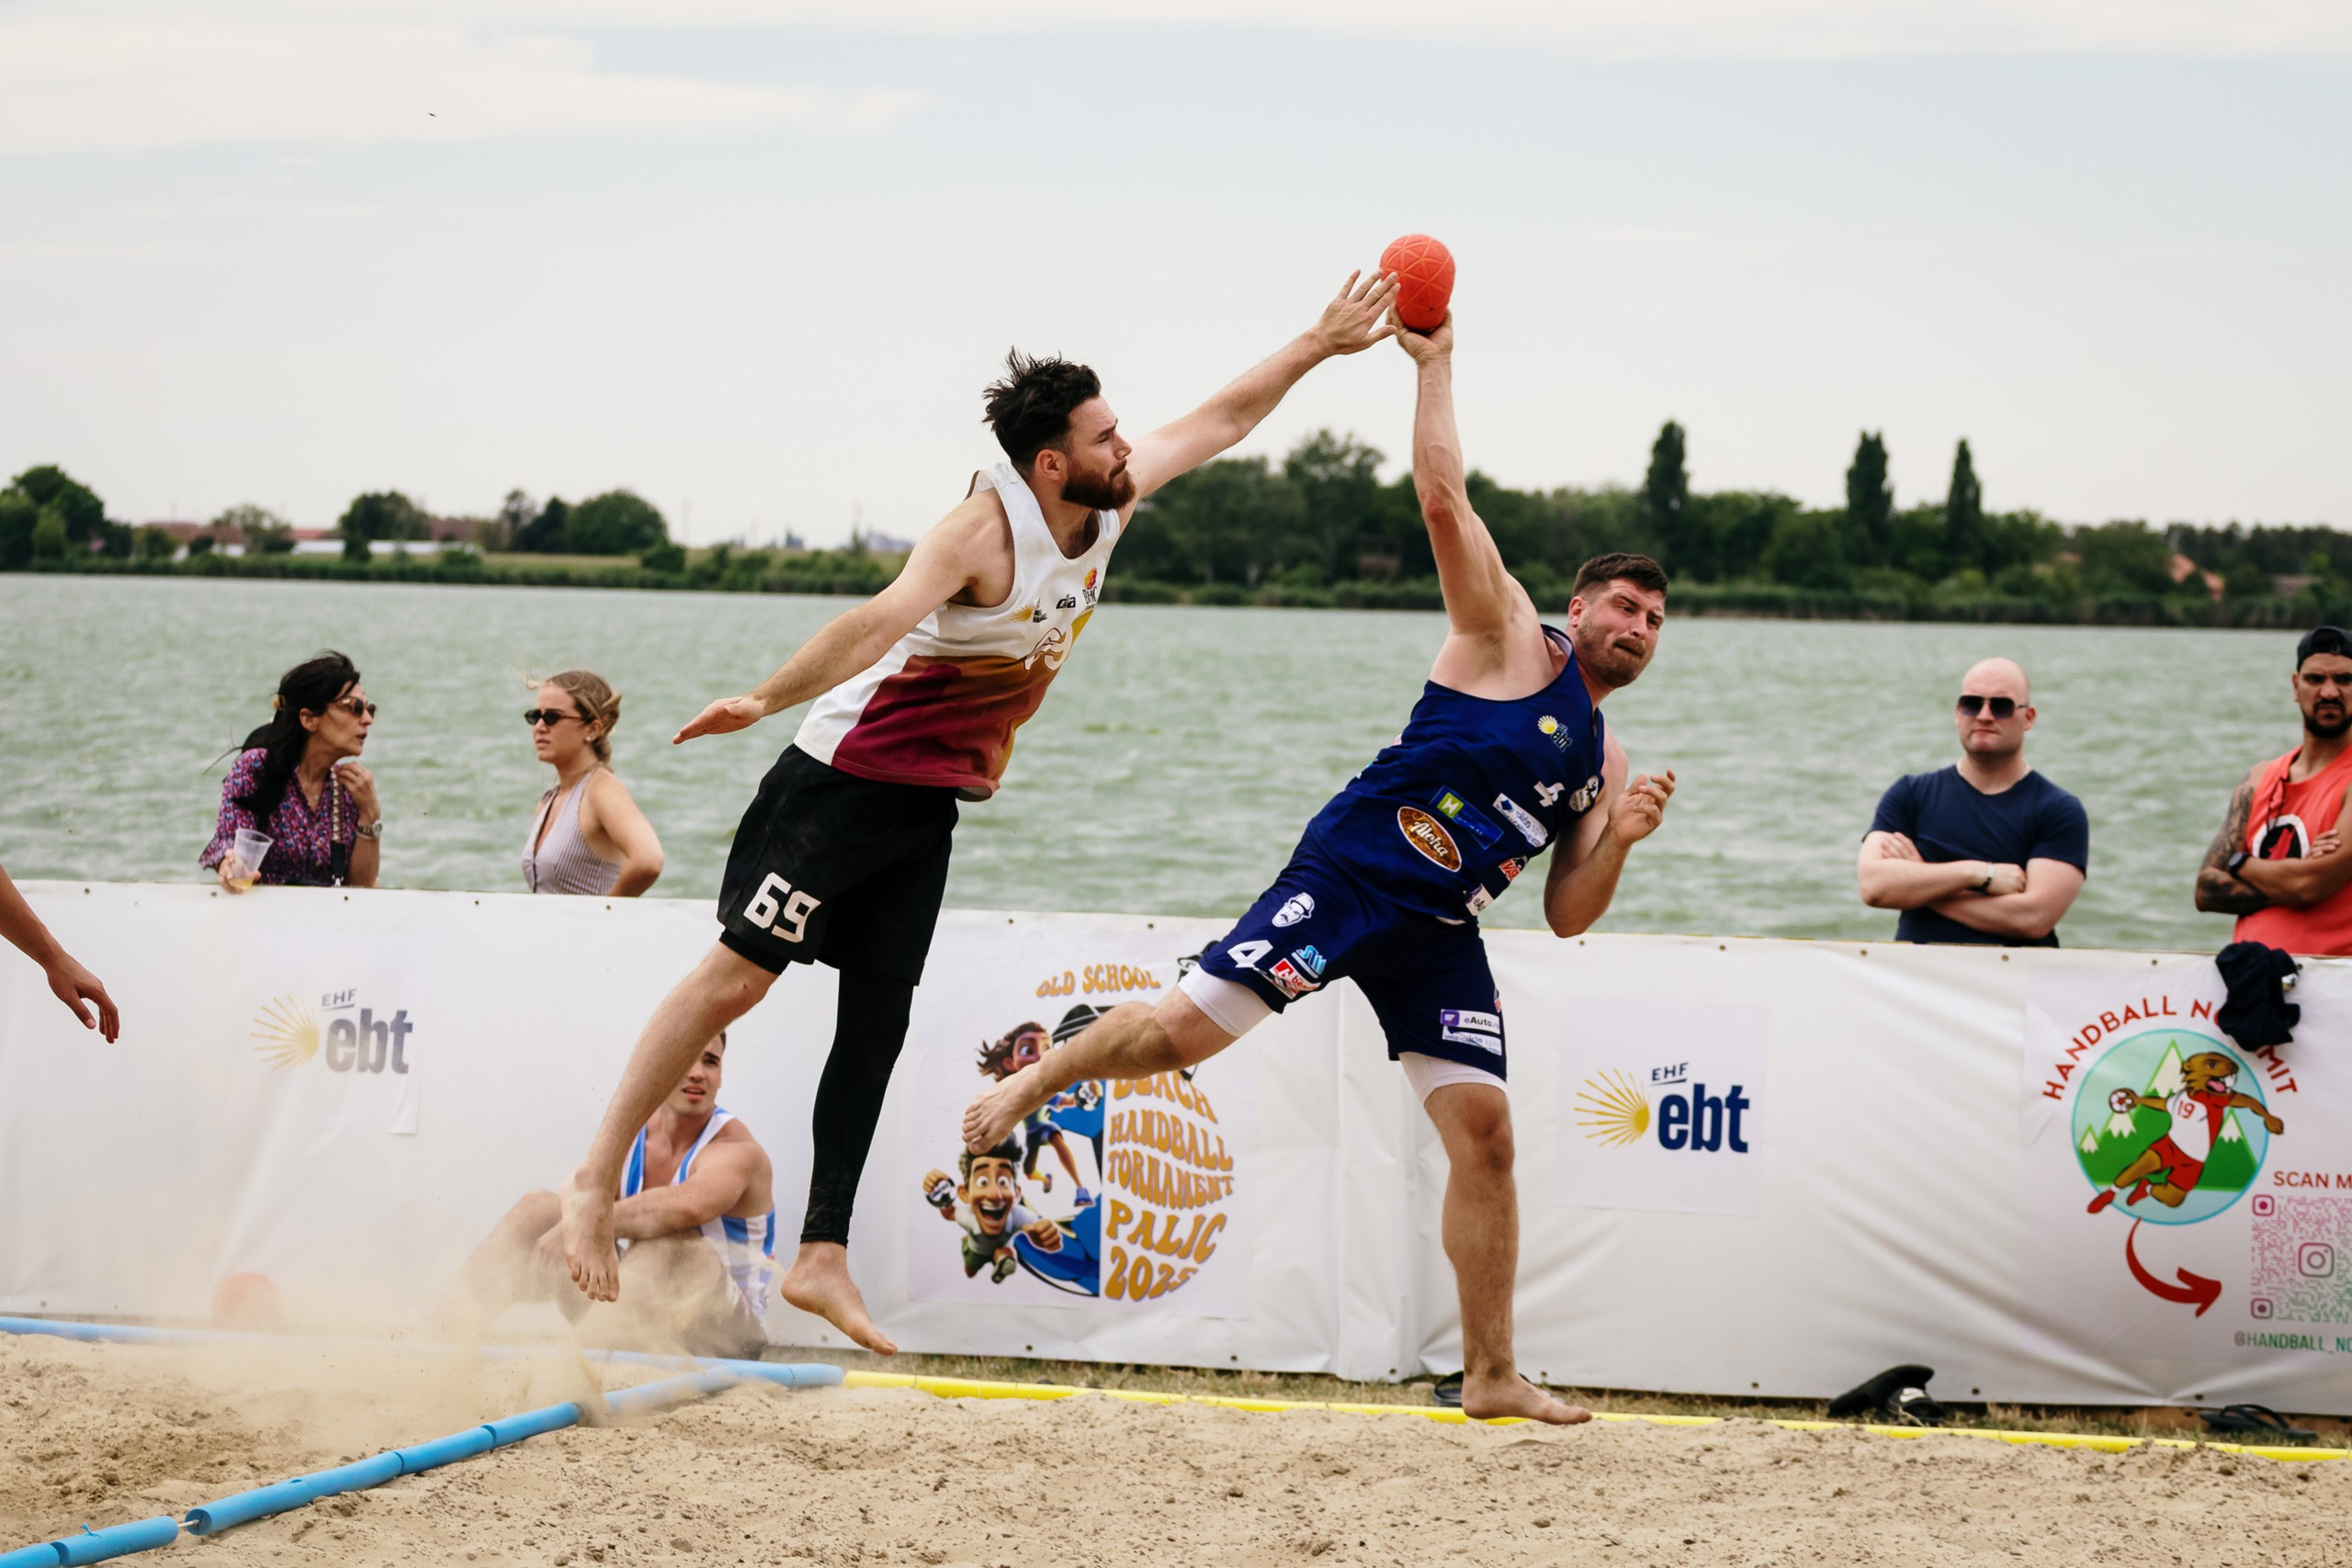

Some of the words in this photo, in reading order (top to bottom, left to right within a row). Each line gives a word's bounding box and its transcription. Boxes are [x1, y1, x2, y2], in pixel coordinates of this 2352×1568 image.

[1410, 821, 1449, 857] Aloha
[742, 872, 822, 943] 69
[1035, 970, 1076, 998] OLD
[1082, 964, 1161, 994] SCHOOL
[1227, 939, 1274, 969] 4
[322, 988, 357, 1007] EHF
[325, 1008, 413, 1075] ebt
[2041, 995, 2177, 1100] HANDBALL
[1651, 1062, 1689, 1081] EHF
[1657, 1082, 1750, 1154] ebt
[2177, 1100, 2195, 1119] 19
[1108, 1109, 1234, 1172] HANDBALL
[1107, 1148, 1235, 1211] TORNAMENT
[2273, 1170, 2329, 1189] SCAN
[1106, 1198, 1227, 1265] PALIC
[1104, 1245, 1199, 1303] 2025
